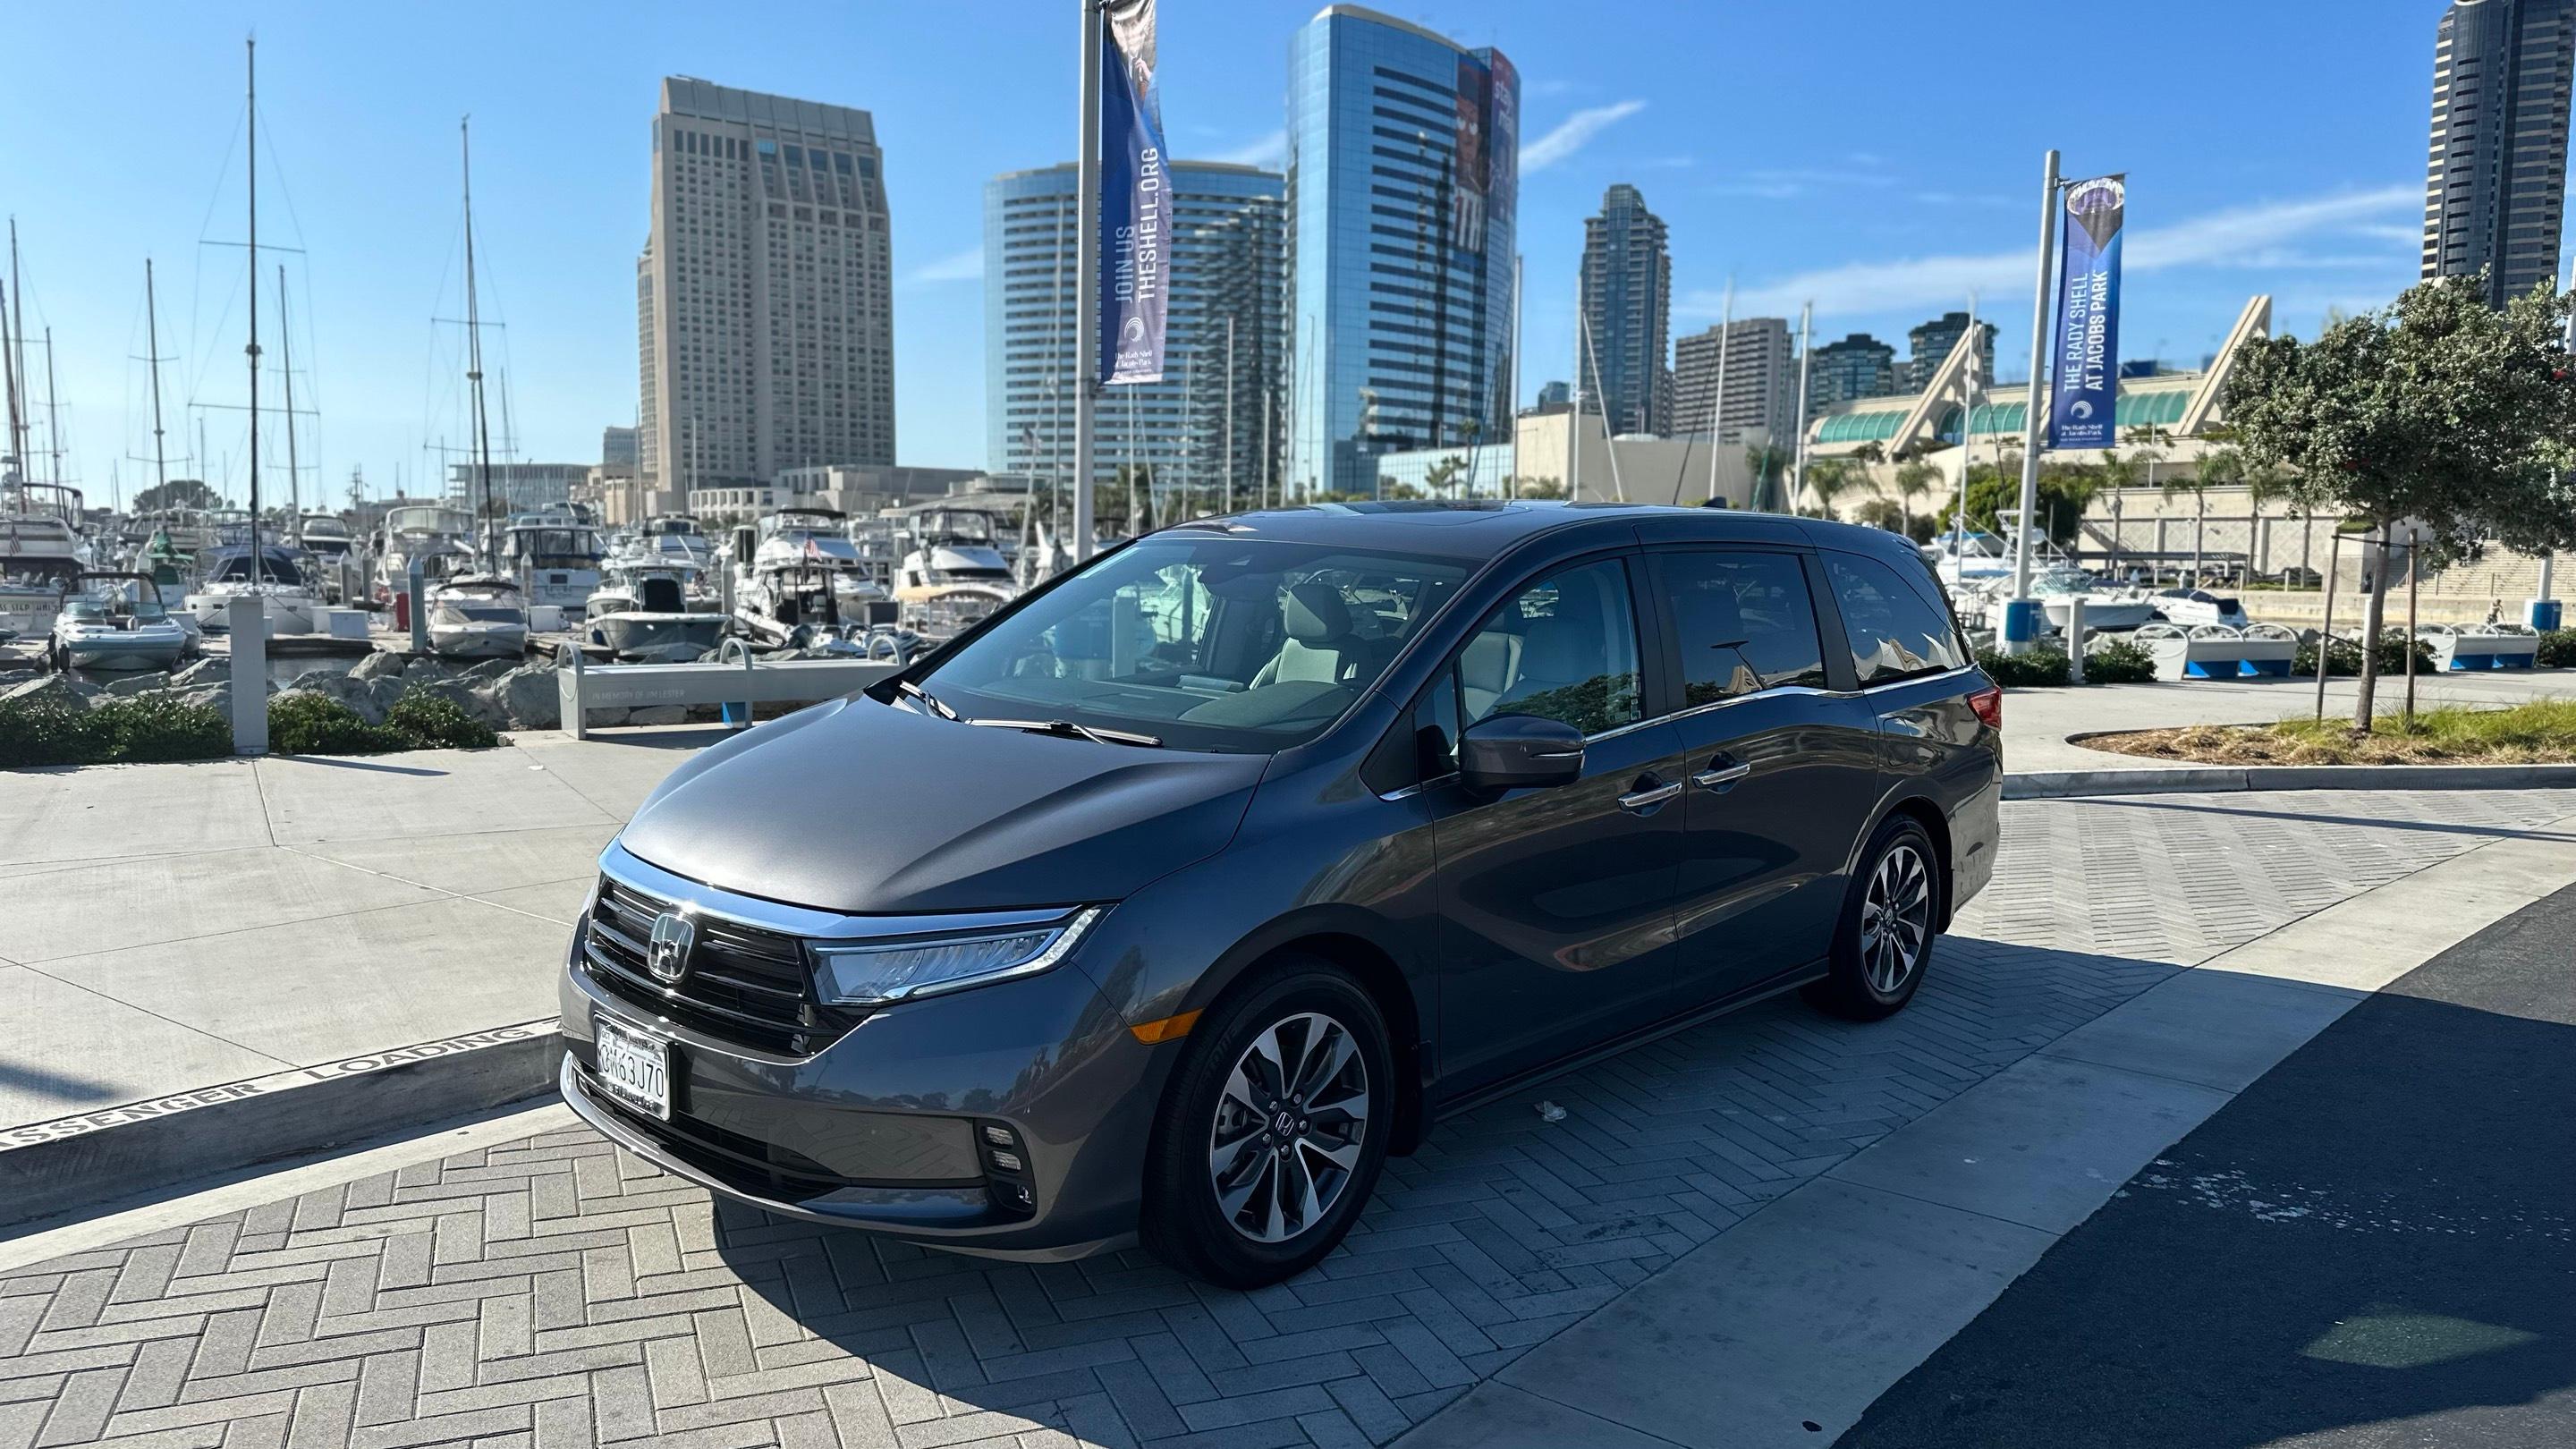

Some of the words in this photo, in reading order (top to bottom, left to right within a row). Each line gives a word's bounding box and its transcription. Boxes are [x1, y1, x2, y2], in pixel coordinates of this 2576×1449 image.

[1115, 225, 1135, 253] US
[1138, 147, 1159, 303] THESHELL.ORG
[1114, 258, 1133, 303] JOIN
[2070, 272, 2089, 318] SHELL
[2090, 269, 2108, 312] PARK
[2066, 322, 2085, 361] RADY
[2086, 314, 2106, 370] JACOBS
[2063, 363, 2082, 393] THE
[2085, 374, 2103, 391] AT
[303, 1028, 534, 1080] LOADING
